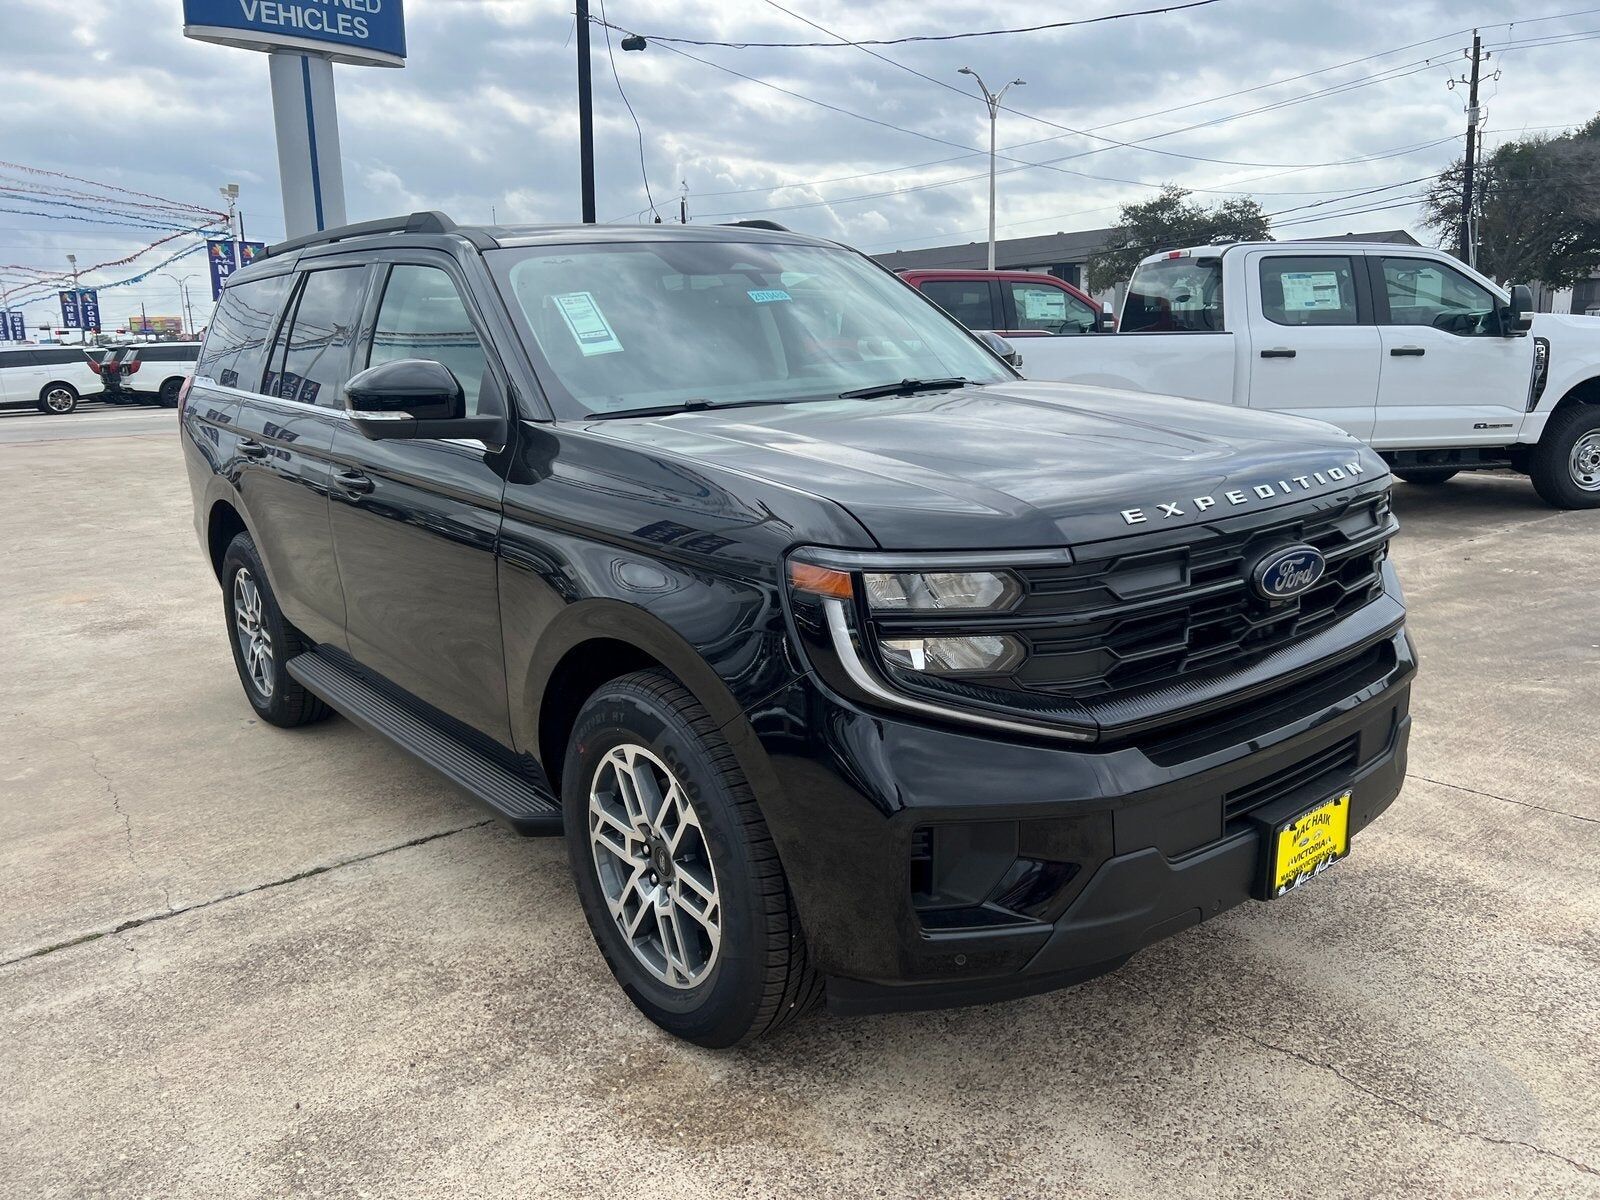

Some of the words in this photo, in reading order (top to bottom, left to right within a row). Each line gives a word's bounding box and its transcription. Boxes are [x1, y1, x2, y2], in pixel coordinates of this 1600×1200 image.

[239, 1, 369, 39] VEHICLES
[65, 305, 77, 327] NEW
[86, 305, 96, 327] FORD
[1120, 461, 1364, 525] EXPEDITION
[1274, 556, 1315, 592] Ford
[1292, 818, 1311, 847] MAC
[1311, 812, 1331, 826] HAIK
